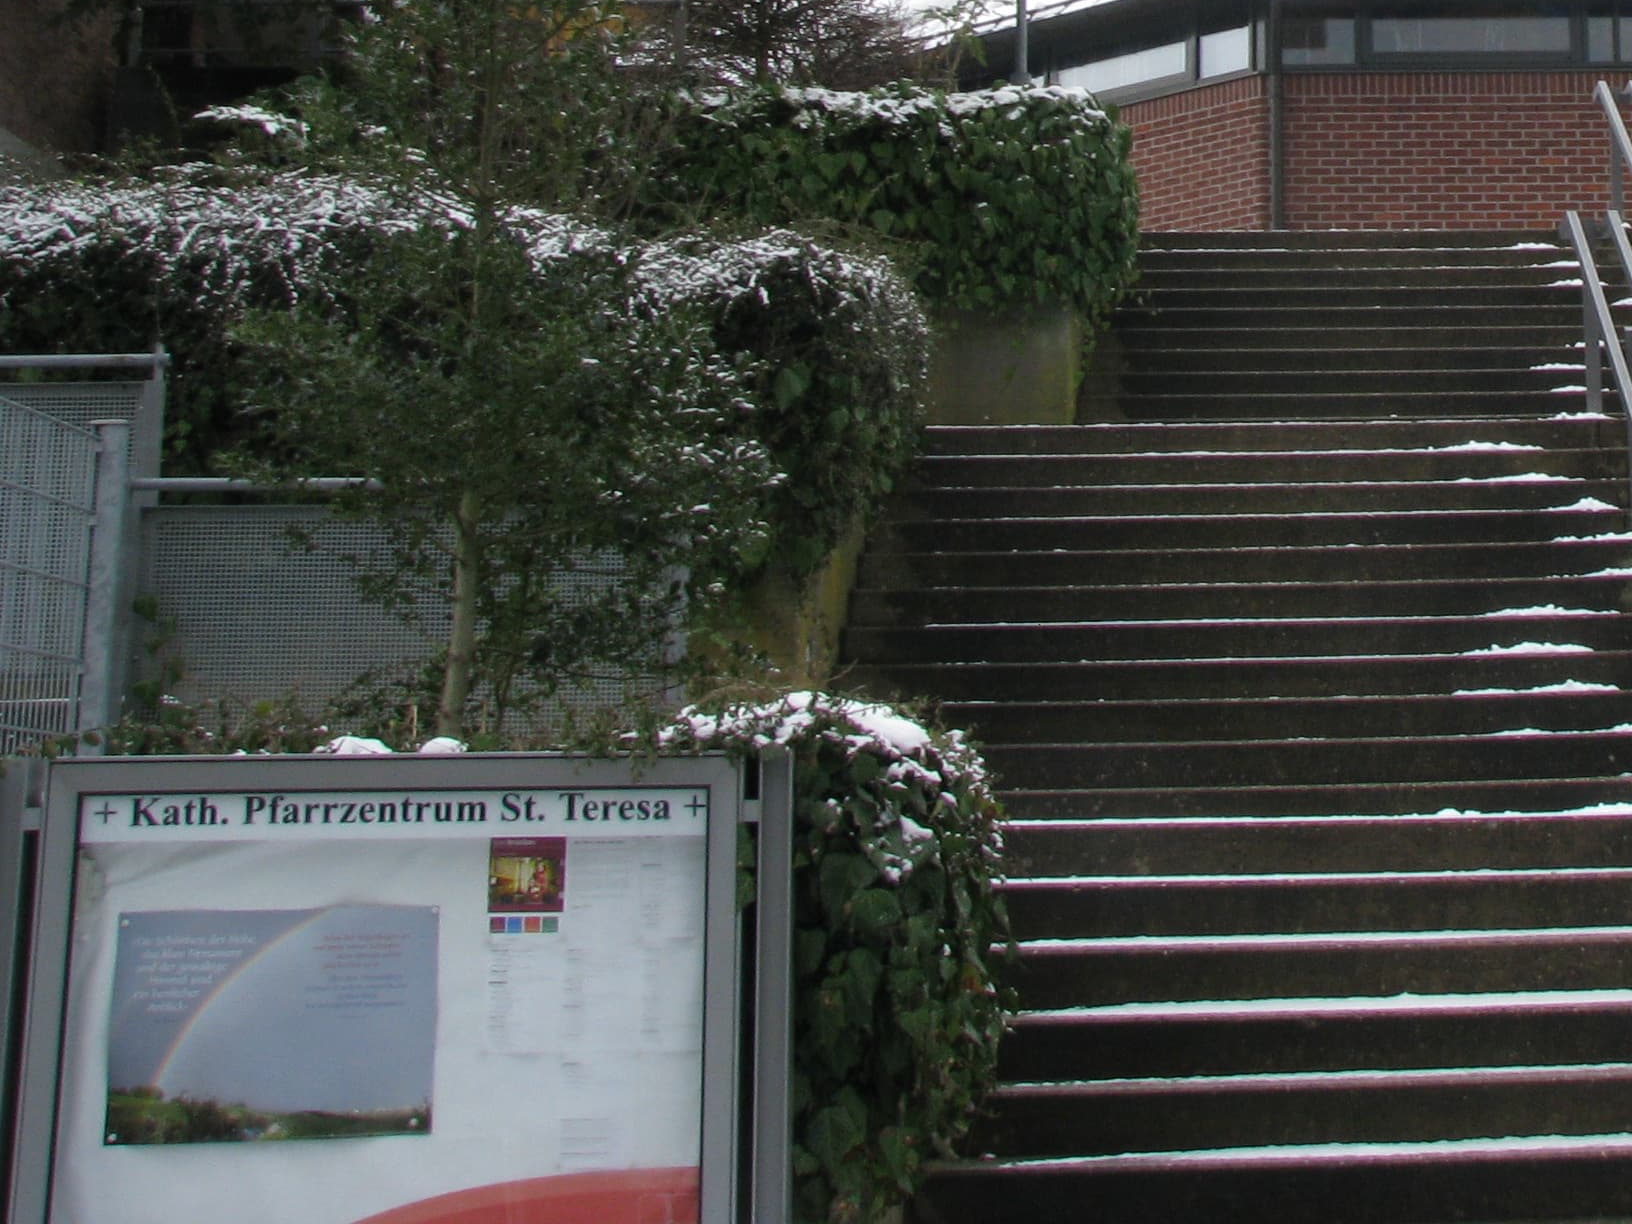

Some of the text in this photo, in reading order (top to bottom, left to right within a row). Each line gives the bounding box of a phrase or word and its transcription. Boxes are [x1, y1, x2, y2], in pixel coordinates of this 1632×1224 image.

[131, 792, 671, 827] Kath. Pfarrzentrum St. Teresa
